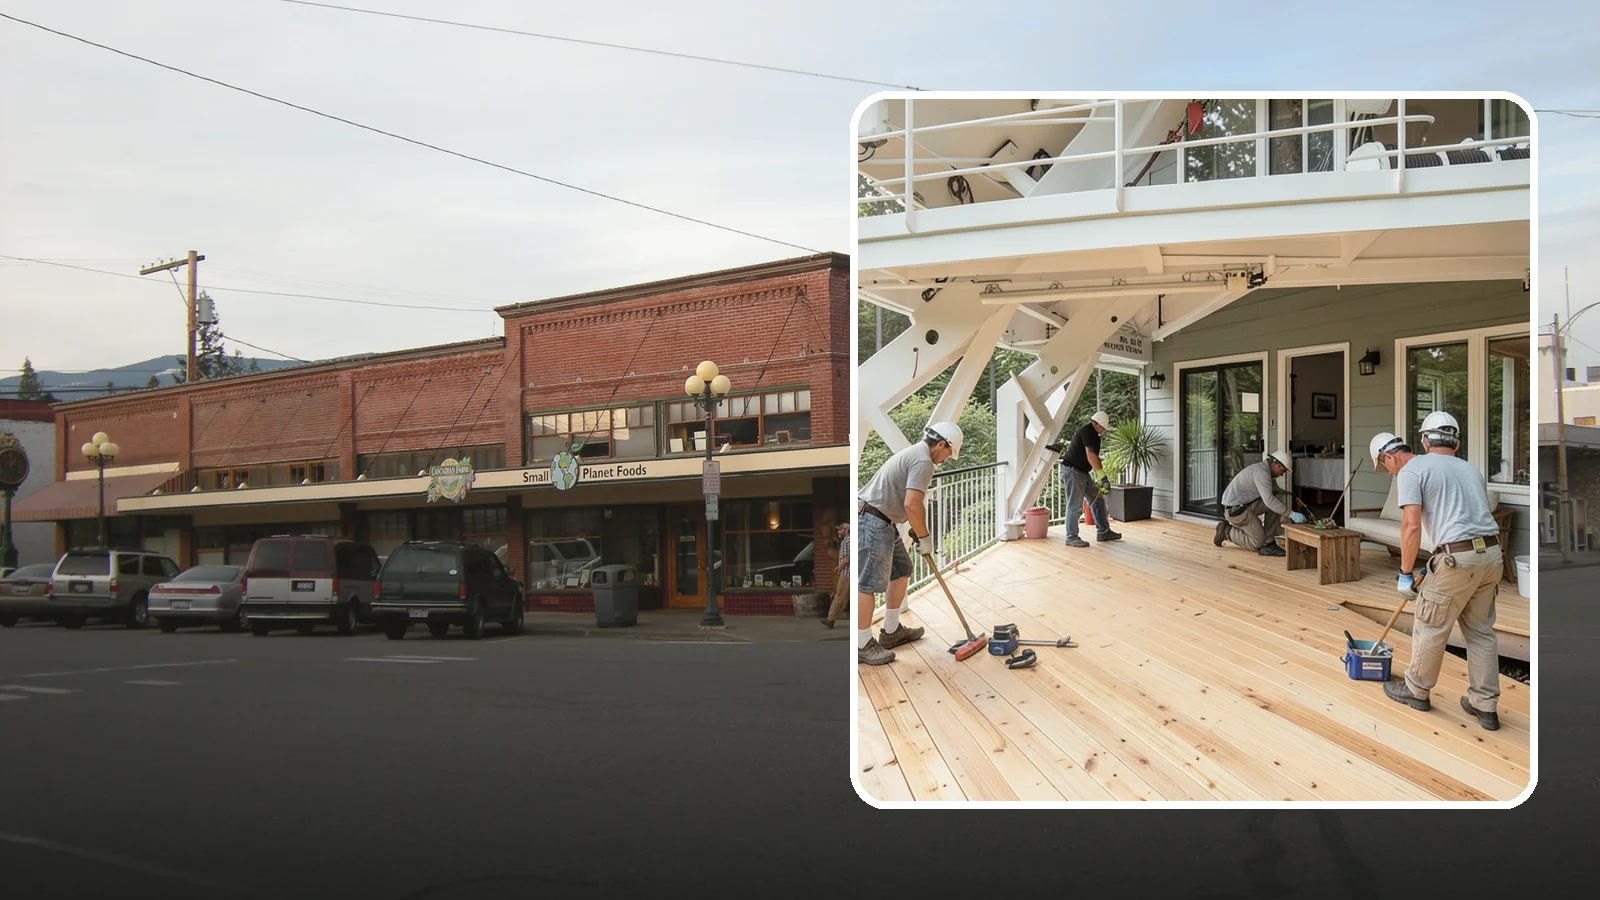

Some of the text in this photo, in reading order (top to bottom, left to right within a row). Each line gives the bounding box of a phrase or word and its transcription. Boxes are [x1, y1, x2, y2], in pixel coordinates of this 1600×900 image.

[523, 464, 647, 483] Small Planet Foods
